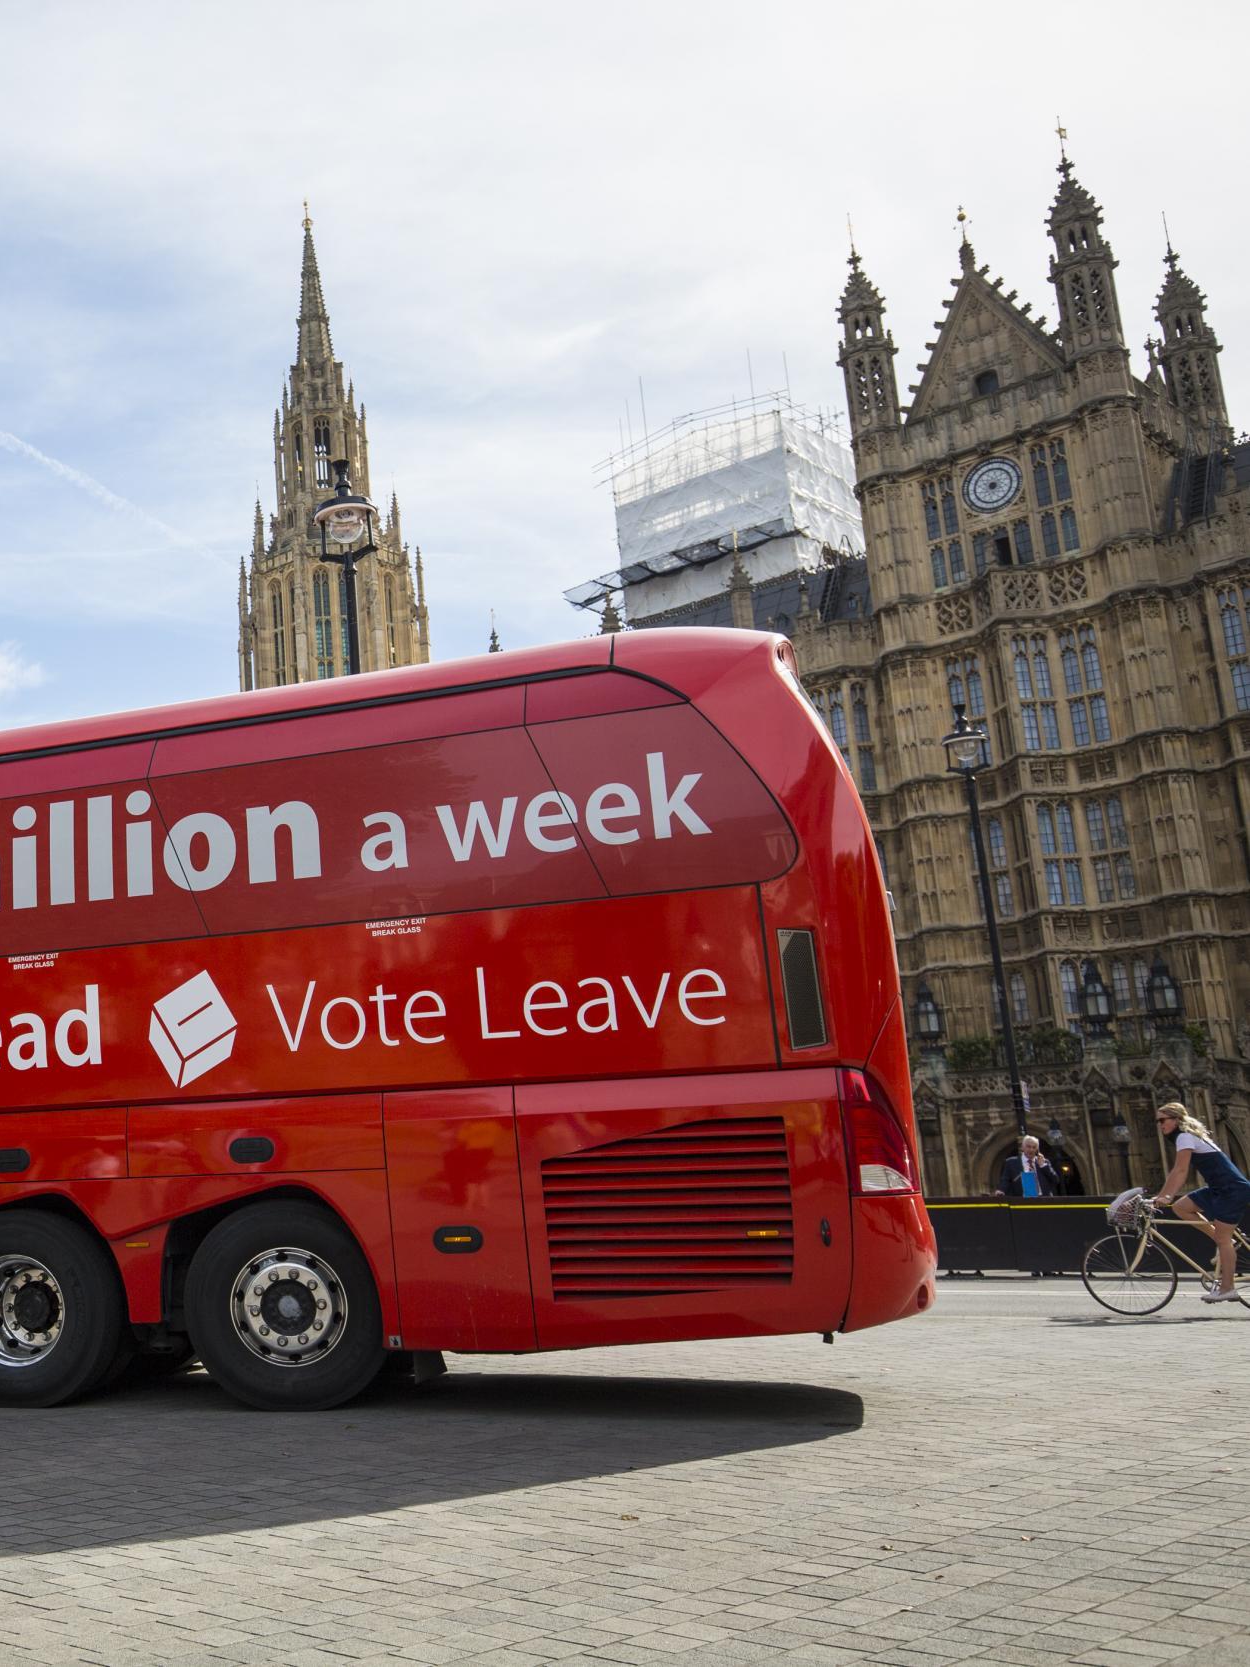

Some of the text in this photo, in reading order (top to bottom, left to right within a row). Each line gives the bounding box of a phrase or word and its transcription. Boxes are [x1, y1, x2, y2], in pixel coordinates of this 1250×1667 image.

[361, 812, 408, 871] a
[435, 752, 712, 862] week
[366, 917, 426, 929] EMERGENCY EXIT
[372, 926, 422, 937] BREAK GLASS
[8, 952, 59, 963] EMERGENCY EXIT
[266, 967, 726, 1051] Vote Leave
